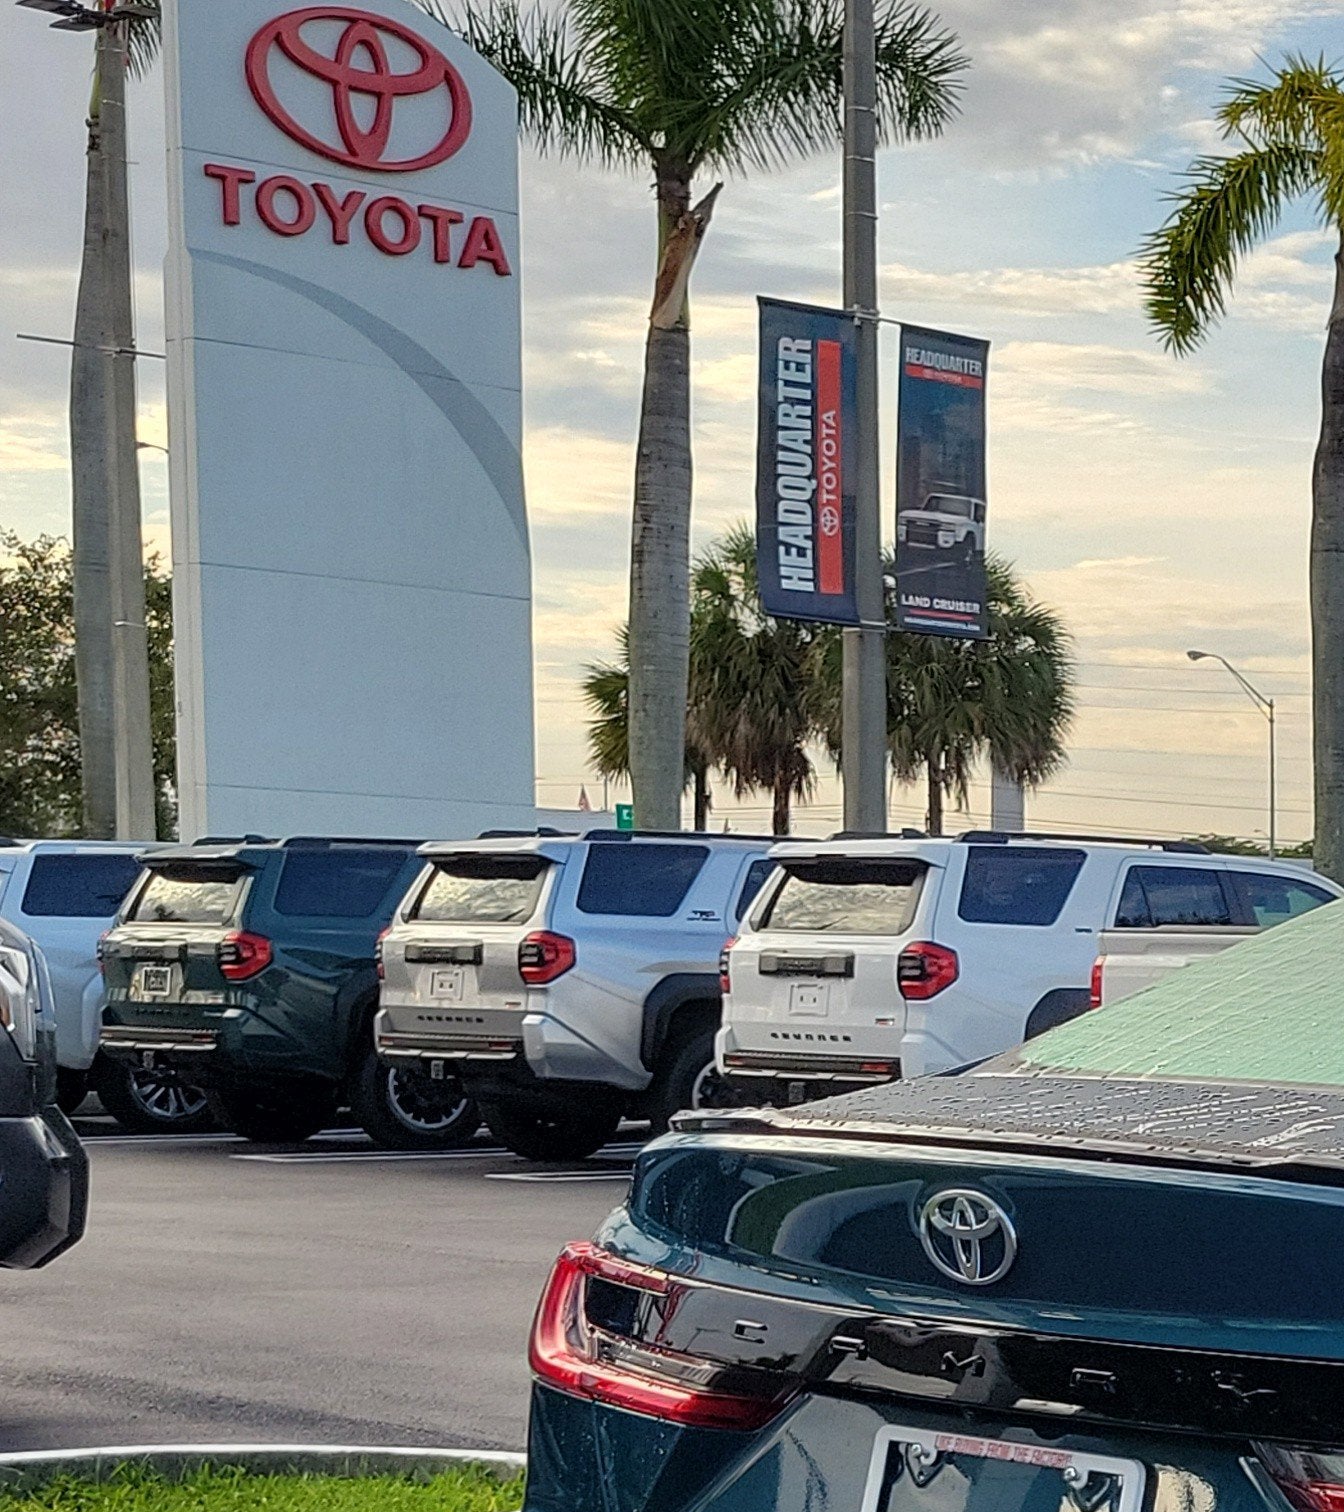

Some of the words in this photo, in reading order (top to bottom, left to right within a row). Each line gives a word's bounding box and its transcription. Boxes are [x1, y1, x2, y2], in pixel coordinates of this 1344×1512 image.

[203, 163, 512, 277] TOYOTA
[905, 347, 983, 376] HEADQUARTER
[776, 337, 818, 592] HEADQUARTER
[821, 410, 837, 504] TOYOTA
[901, 594, 931, 608] LAND
[933, 598, 981, 615] CRUISER
